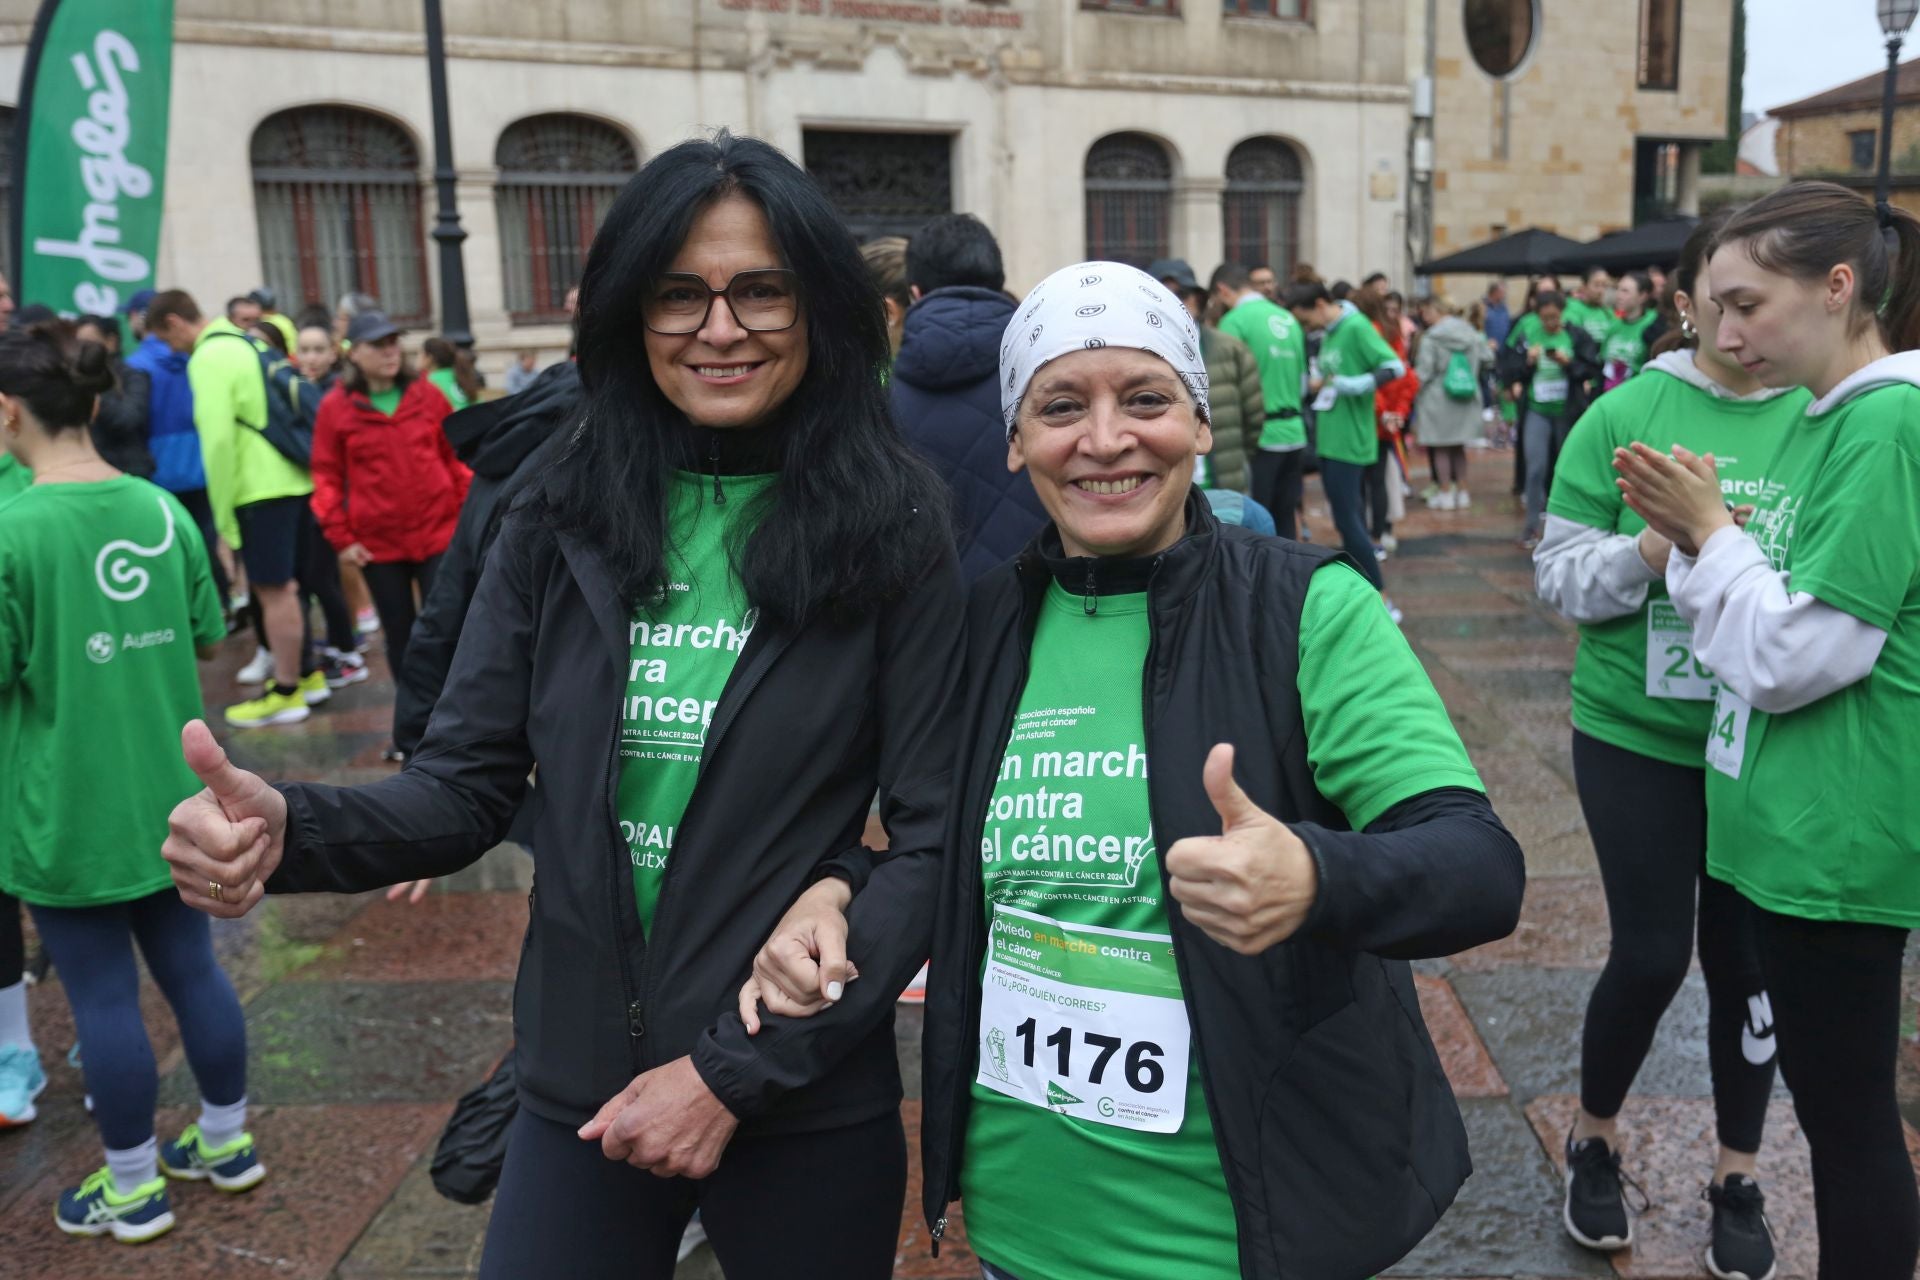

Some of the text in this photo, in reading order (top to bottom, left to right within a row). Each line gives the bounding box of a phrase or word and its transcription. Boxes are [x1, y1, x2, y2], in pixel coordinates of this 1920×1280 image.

[34, 29, 154, 283] Inglés
[629, 658, 668, 683] ra
[622, 694, 718, 726] ncer
[1019, 706, 1096, 720] asociación española
[642, 729, 651, 737] EL
[653, 728, 681, 739] CÁNCER
[682, 731, 699, 740] 2024
[1018, 717, 1078, 730] contra el cáncer
[1016, 730, 1056, 741] en Asturias
[620, 750, 646, 759] CONTRA
[646, 751, 656, 759] EL
[656, 751, 682, 761] CÁNCER
[683, 754, 693, 762] EN
[1032, 744, 1148, 779] march
[981, 824, 1143, 864] el cáncer
[1012, 869, 1040, 877] MARCHA
[1040, 870, 1065, 878] CONTRA
[1065, 871, 1074, 879] EL
[1075, 871, 1105, 880] CÁNCER
[1106, 872, 1123, 881] 2024
[1043, 892, 1073, 901] CONTRA
[1082, 893, 1109, 903] CÁNCER
[1109, 896, 1120, 904] EN
[1121, 895, 1157, 906] ASTURIAS
[994, 919, 1032, 939] Oviedo
[1034, 931, 1047, 944] en
[1049, 936, 1097, 955] marcha
[1101, 945, 1152, 962] contra
[996, 938, 1042, 961] el cáncer
[1019, 959, 1037, 970] CONTRA
[991, 973, 997, 984] Y
[1008, 981, 1028, 996] ¿POR
[1057, 996, 1107, 1012] CORRES?
[1016, 1017, 1165, 1093] 1176
